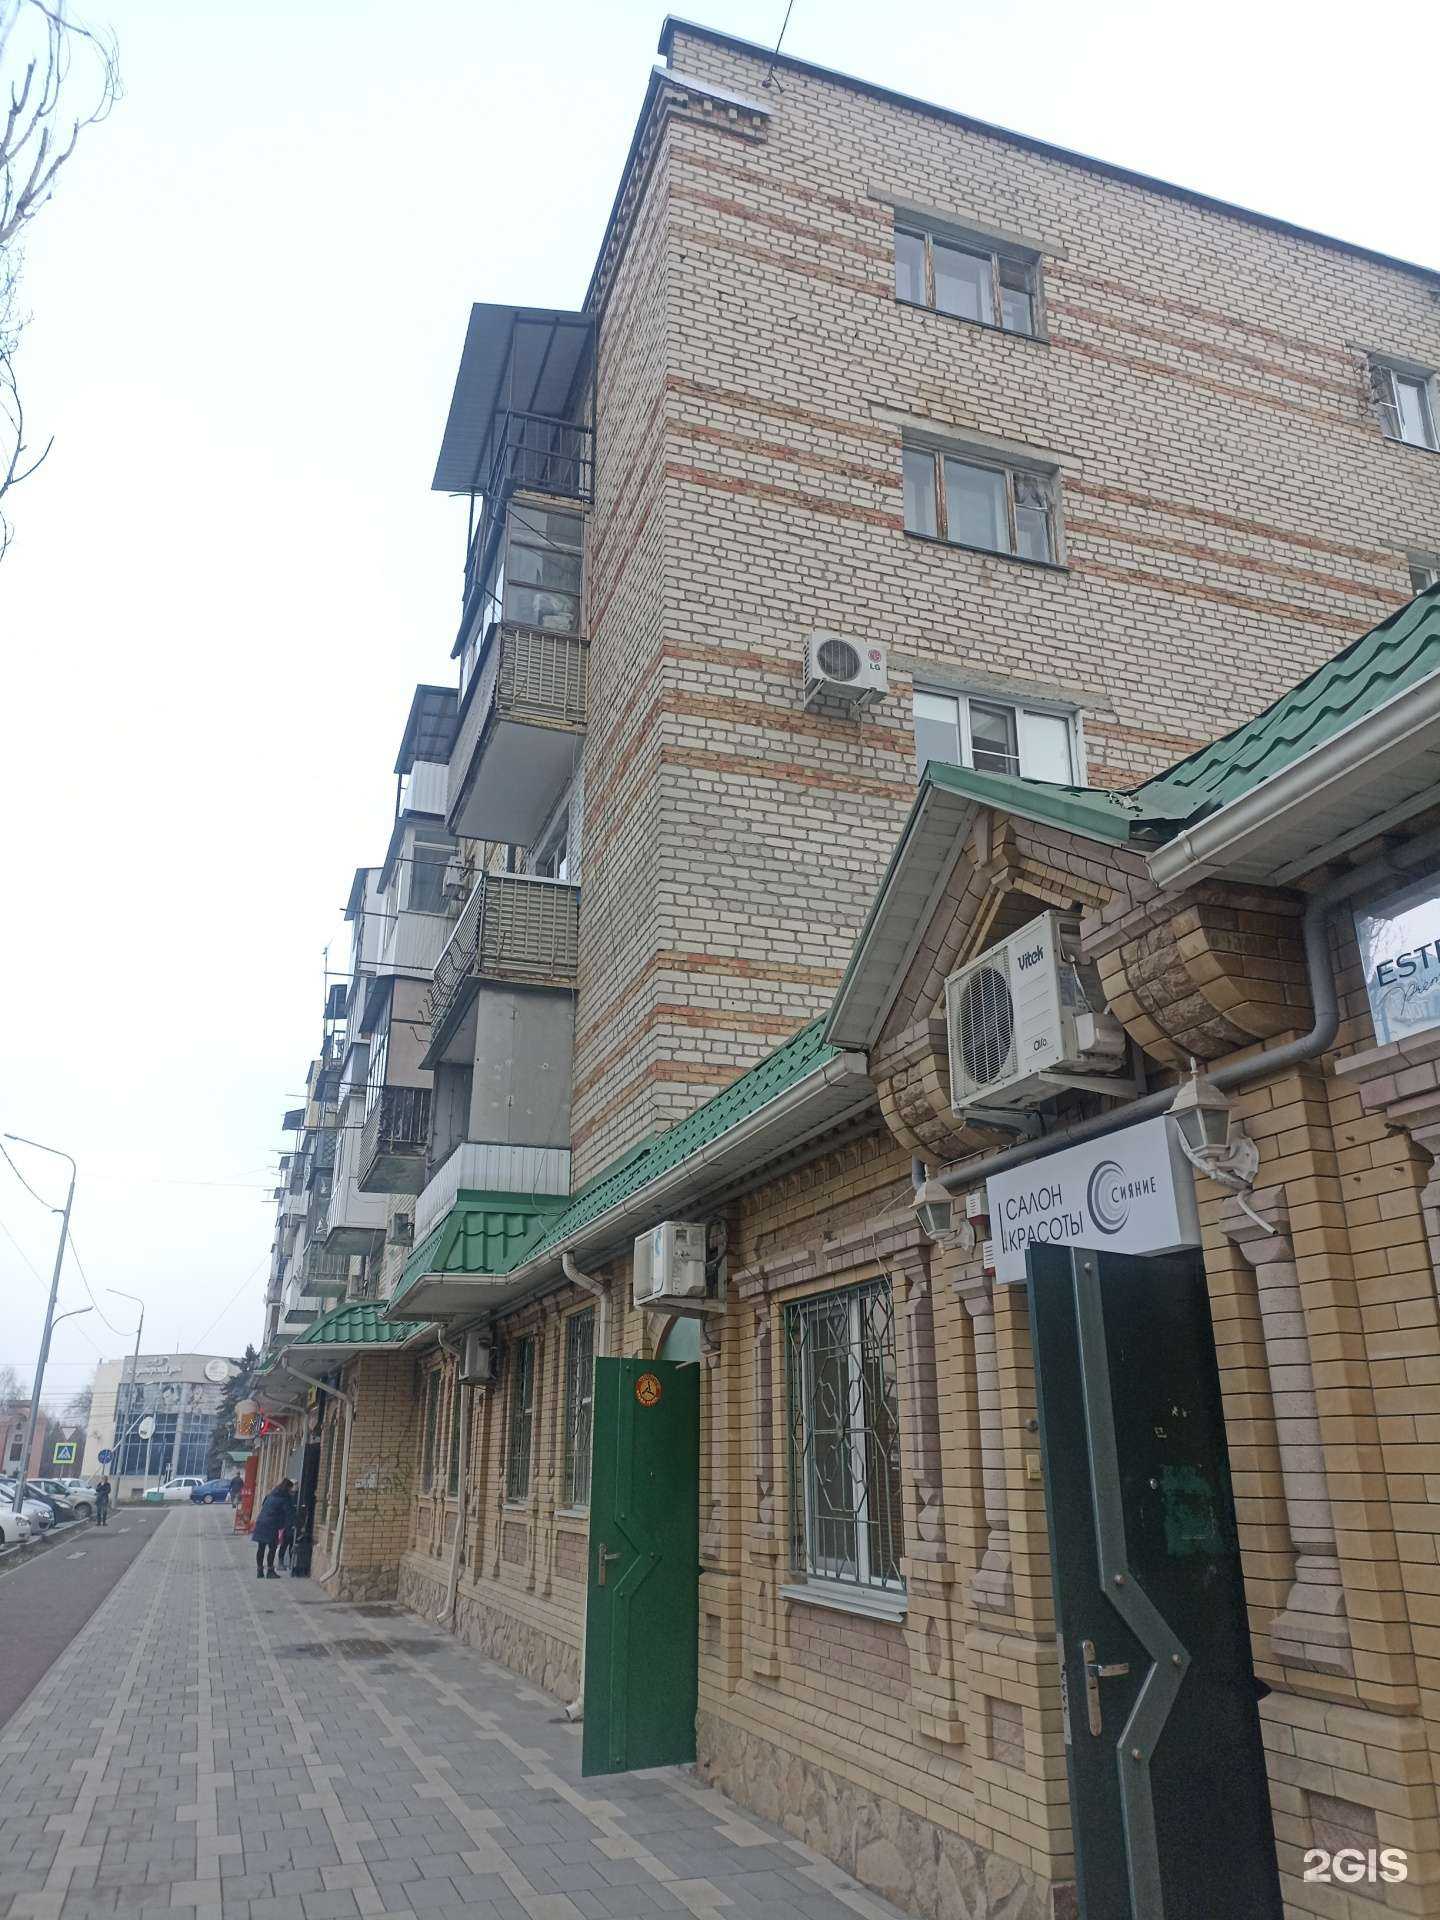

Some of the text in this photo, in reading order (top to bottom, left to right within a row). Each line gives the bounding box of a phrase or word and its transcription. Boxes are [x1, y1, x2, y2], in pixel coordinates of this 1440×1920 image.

[1017, 945, 1043, 970] Vitek
[1006, 1184, 1063, 1220] САЛОН
[1111, 1176, 1157, 1203] СИЯНИЕ
[1009, 1211, 1084, 1251] КРАСОТЫ
